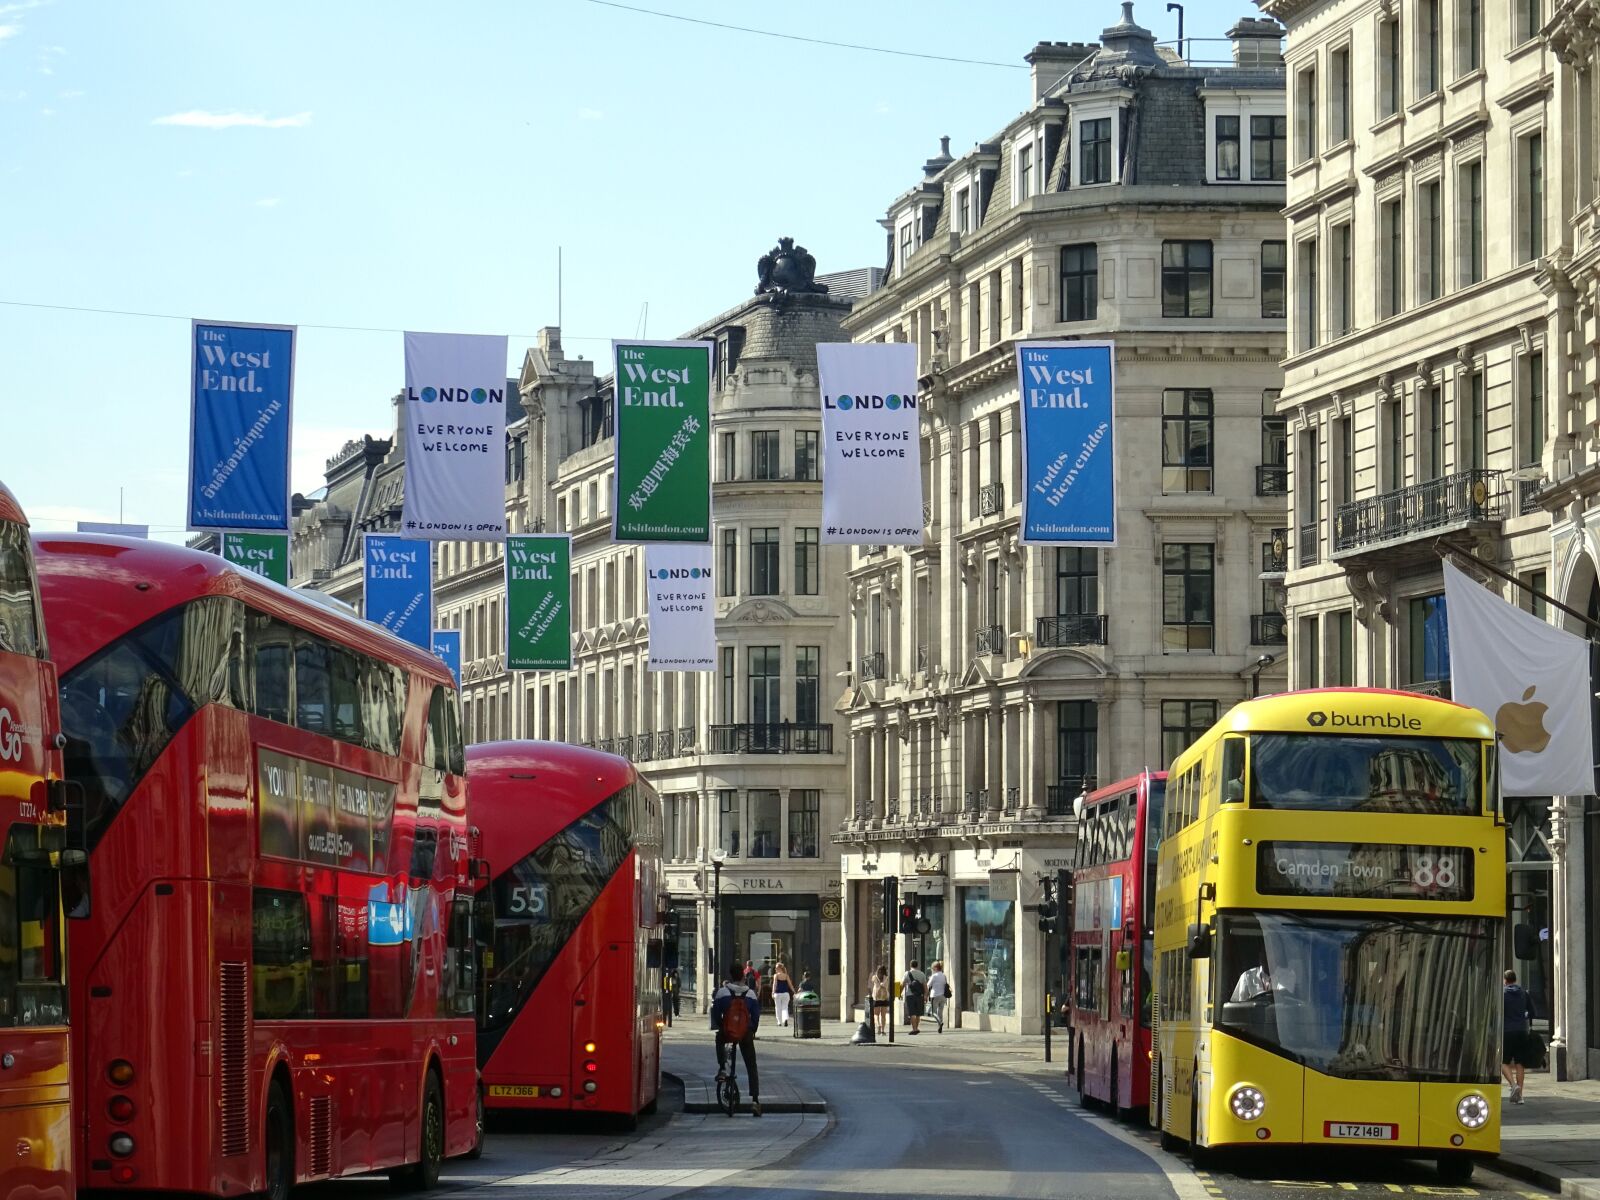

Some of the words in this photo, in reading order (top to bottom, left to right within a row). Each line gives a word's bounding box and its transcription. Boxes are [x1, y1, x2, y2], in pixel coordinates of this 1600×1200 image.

[202, 330, 226, 342] The
[201, 345, 271, 369] West
[621, 349, 645, 360] The
[1025, 352, 1049, 362] The
[623, 363, 690, 384] West
[1028, 365, 1094, 385] West
[202, 369, 263, 394] End.
[624, 387, 684, 408] End.
[1030, 388, 1089, 409] End.
[418, 423, 493, 436] EVERYONE
[836, 430, 909, 442] EVERYONE
[423, 441, 488, 453] WELCOME
[842, 448, 905, 458] WELCOME
[627, 415, 701, 512] 欢迎四海宾客
[1046, 421, 1108, 508] bienvenidos
[1032, 451, 1069, 496] Todos
[197, 510, 282, 522] visitlondon.com
[621, 523, 704, 534] visitlondon.com
[1029, 523, 1110, 534] visitlondon.com
[227, 535, 244, 544] The
[370, 539, 386, 547] The
[511, 540, 526, 548] The
[228, 545, 274, 560] West
[370, 549, 416, 563] West
[511, 550, 557, 564] West
[370, 564, 413, 579] End.
[511, 566, 553, 580] End.
[656, 592, 706, 601] EVERYONE
[392, 591, 424, 633] envenus
[518, 590, 554, 639] Everyone
[660, 604, 704, 612] WELCOME
[529, 599, 563, 645] welcome
[511, 657, 568, 665] visitlondon.com
[1331, 710, 1422, 731] bumble
[1276, 858, 1339, 876] Camden
[1344, 860, 1384, 878] Town
[1415, 856, 1455, 888] 88
[743, 878, 784, 889] FURLA
[510, 887, 544, 913] 55
